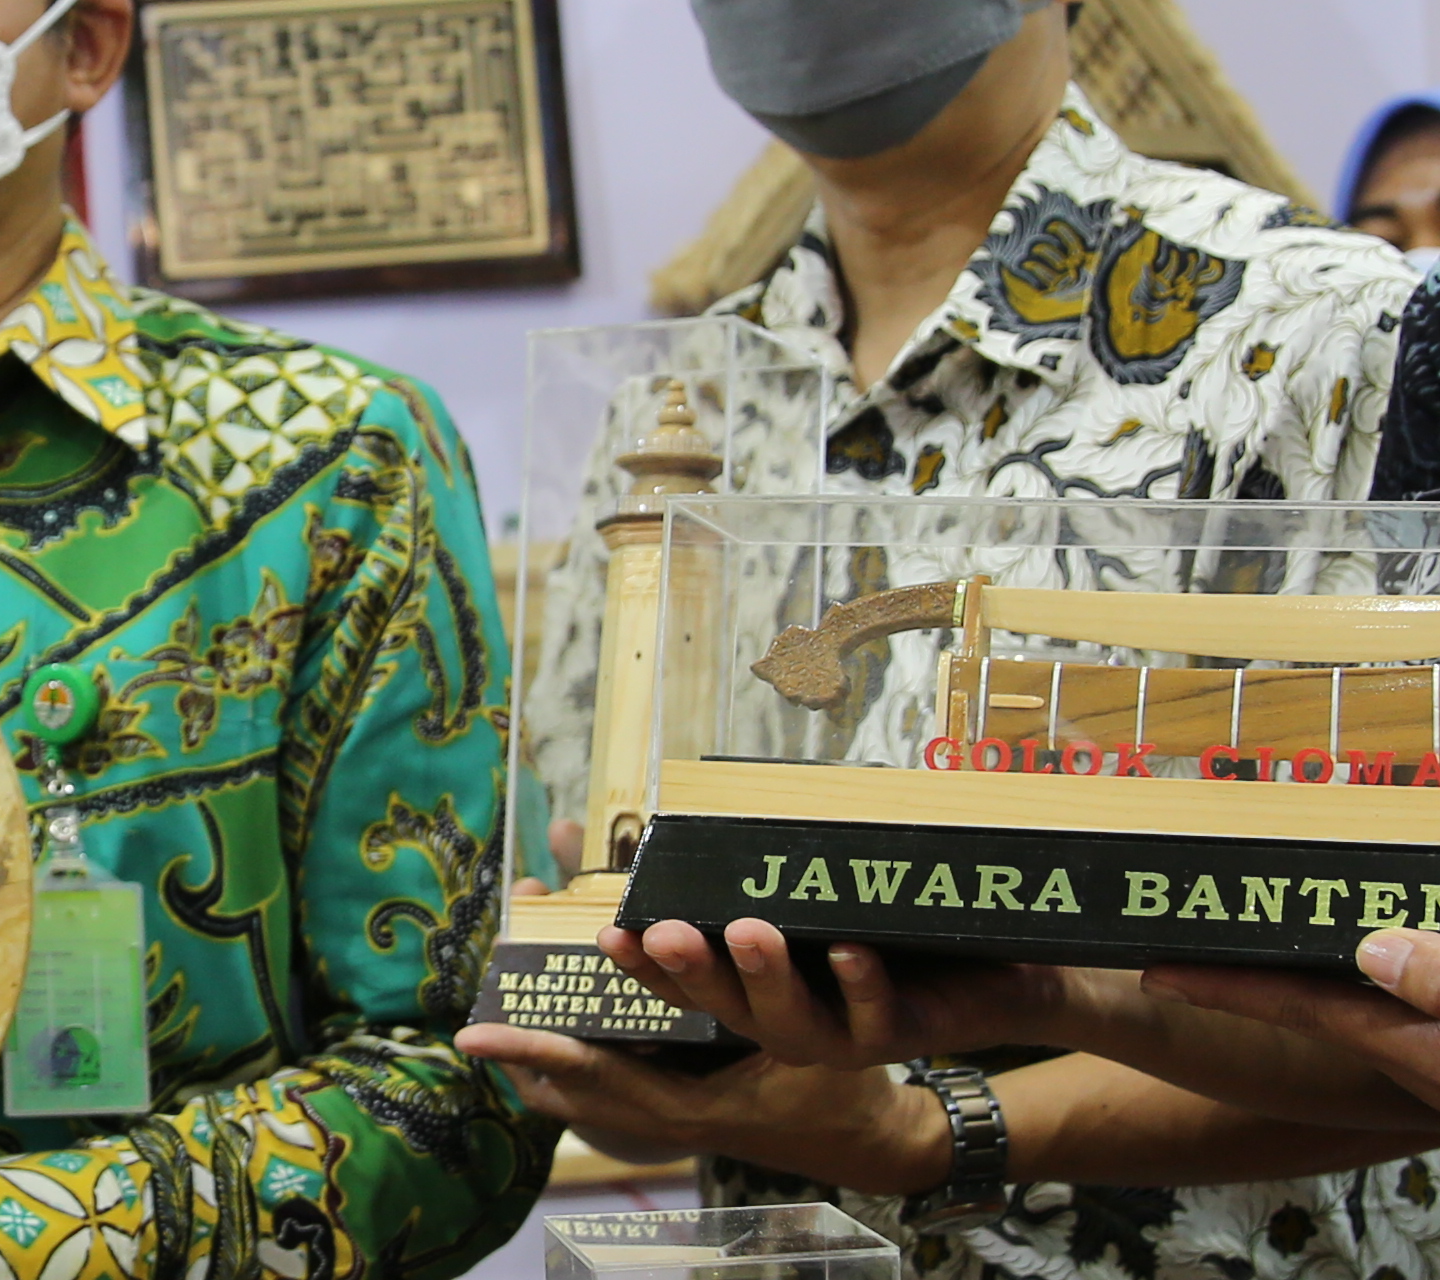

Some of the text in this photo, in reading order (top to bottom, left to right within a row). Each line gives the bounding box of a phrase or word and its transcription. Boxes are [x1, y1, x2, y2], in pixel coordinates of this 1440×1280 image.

[924, 735, 1158, 779] GOLOK
[741, 853, 1082, 915] JAWARA
[544, 953, 624, 975] MENA
[497, 971, 596, 995] MASJID
[500, 992, 604, 1016] BANTEN
[507, 1012, 578, 1028] SERANG
[601, 1017, 674, 1032] BANTEN
